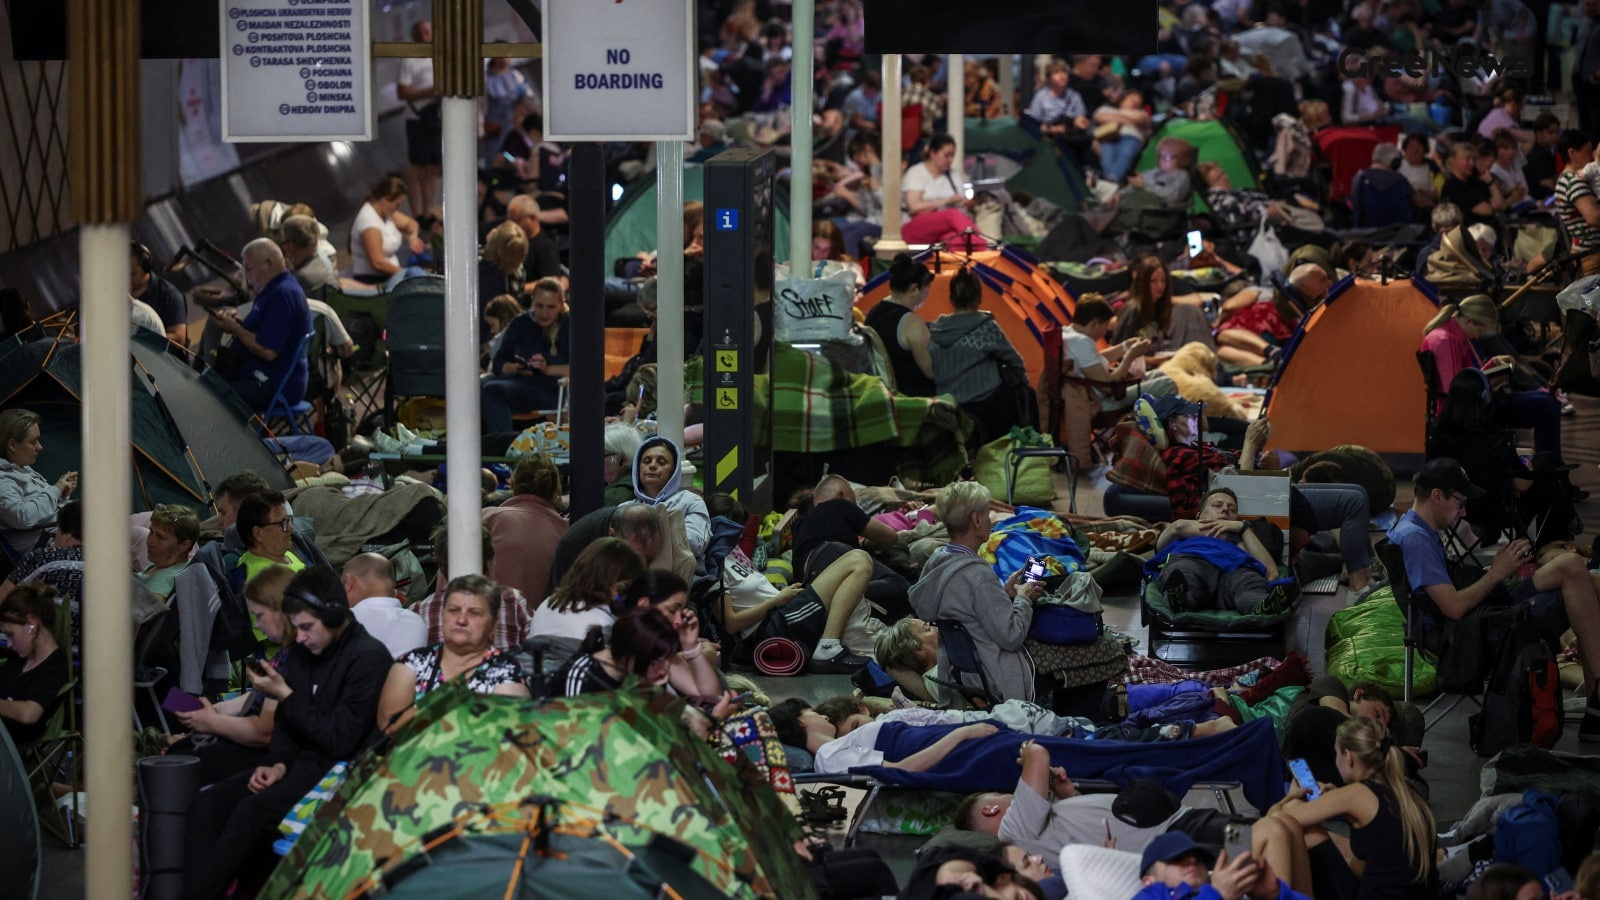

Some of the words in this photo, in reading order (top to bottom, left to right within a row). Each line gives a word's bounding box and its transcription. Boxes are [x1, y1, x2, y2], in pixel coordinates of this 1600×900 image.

[249, 21, 282, 29] MAIDAN
[284, 20, 351, 29] NEZALEZHNOSTI
[261, 33, 304, 41] POSHTOVA
[306, 32, 351, 41] PLOSHCHA
[245, 45, 304, 53] KONTRAKTOVA
[306, 44, 351, 53] PLOSHCHA
[262, 57, 294, 65] TARASA
[296, 56, 352, 65] SHEVCHENKA
[606, 49, 631, 65] NO
[312, 69, 352, 77] POCHAINA
[317, 81, 352, 89] OBOLON
[574, 73, 664, 90] BOARDING
[319, 93, 352, 101] MINSKA
[291, 105, 322, 114] HEROIV
[323, 104, 356, 114] DNIPRA
